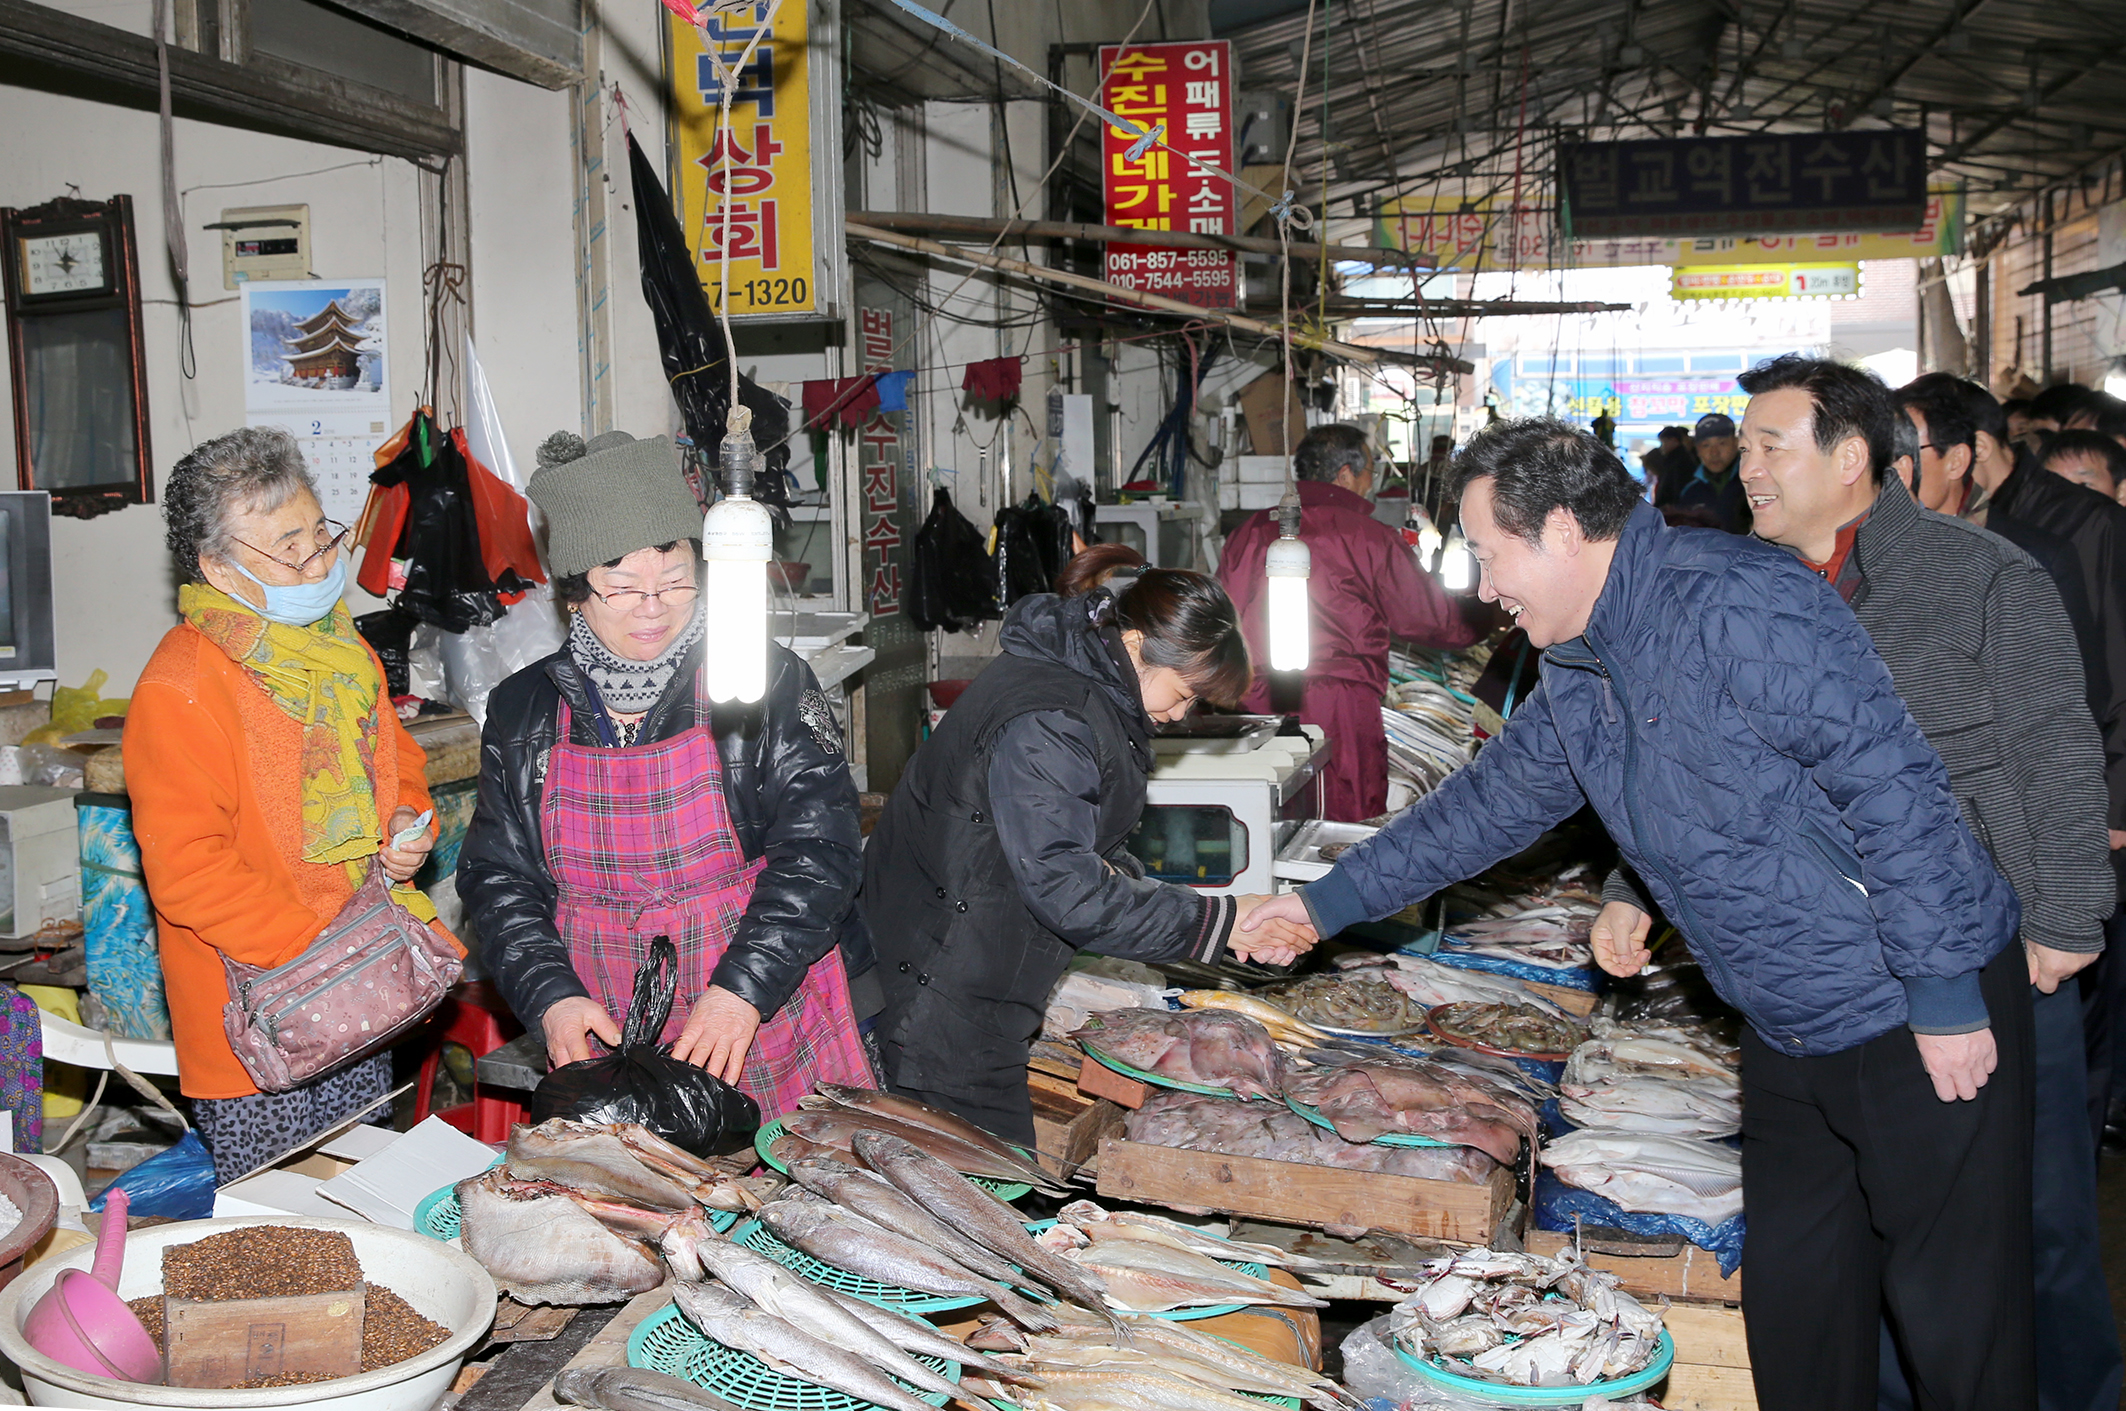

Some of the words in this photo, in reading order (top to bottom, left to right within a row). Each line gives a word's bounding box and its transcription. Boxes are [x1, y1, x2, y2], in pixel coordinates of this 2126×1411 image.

[1184, 49, 1223, 140] 어패류
[1573, 138, 1913, 207] 벌교역전수산
[1109, 249, 1229, 270] 061-857-5595
[1109, 270, 1231, 290] 010-7544-5595
[311, 420, 322, 435] 2
